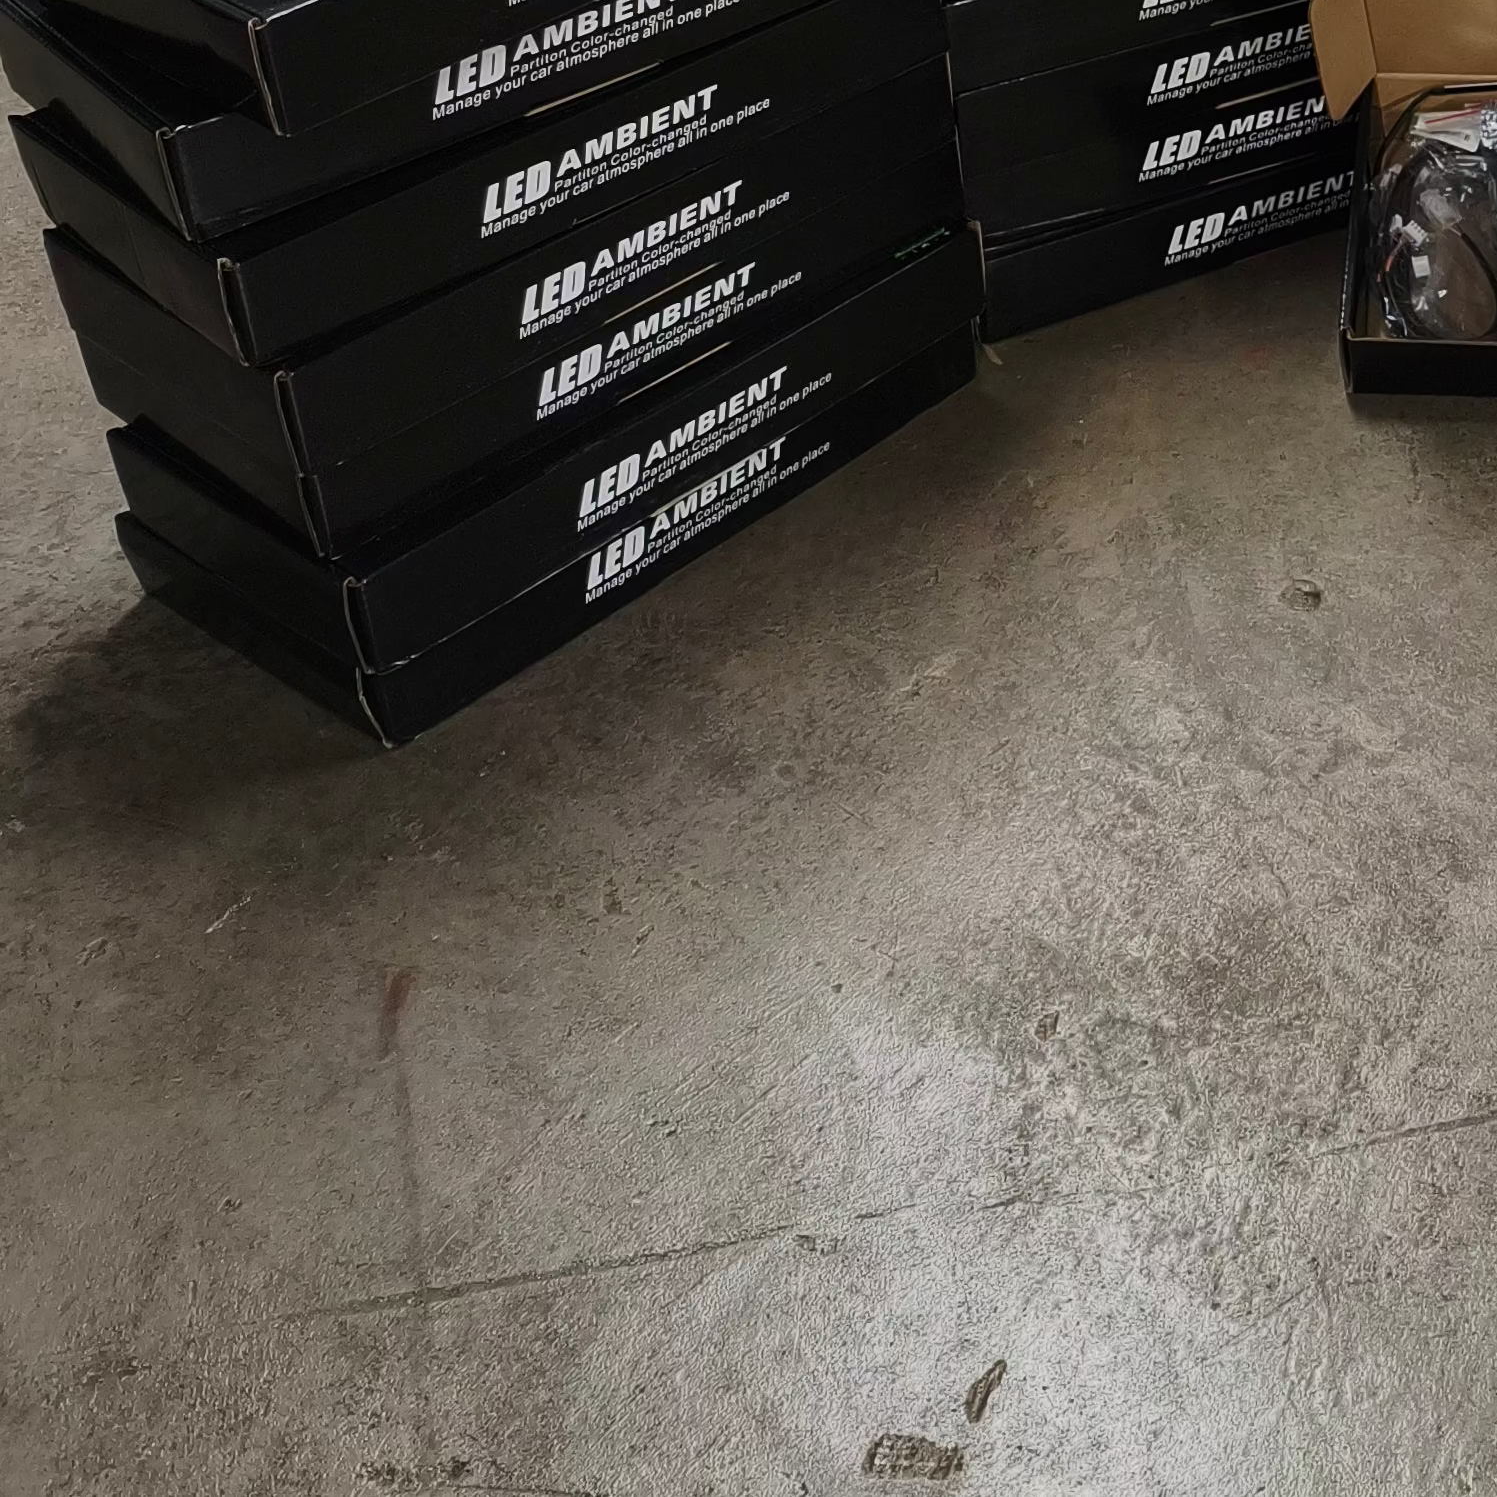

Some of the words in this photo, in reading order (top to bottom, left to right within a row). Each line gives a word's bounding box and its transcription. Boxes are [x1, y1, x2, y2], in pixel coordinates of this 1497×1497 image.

[435, 45, 506, 105] LED
[1150, 51, 1210, 94] LED
[1213, 24, 1311, 66] AMBIE
[481, 204, 536, 239] Manage
[540, 189, 569, 215] your
[572, 177, 594, 197] car
[598, 142, 674, 185] atmosphere
[678, 129, 692, 148] all
[696, 126, 708, 140] in
[710, 115, 733, 133] one
[736, 97, 770, 124] place
[484, 161, 550, 224] LED
[557, 83, 718, 179] AMBIENT
[610, 113, 707, 165] Color-changed
[1142, 130, 1202, 171] LED
[1204, 95, 1326, 144] AMBIEN
[522, 261, 585, 325] LED
[591, 178, 742, 278] AMBIENT
[1168, 212, 1225, 255] LED
[539, 344, 602, 407] LED
[607, 260, 756, 360] AMBIENT
[655, 289, 744, 344] Color-changed
[580, 454, 640, 518] LED
[645, 364, 787, 469] AMBIENT
[588, 526, 644, 591] LED
[650, 434, 786, 541] AMBIENT
